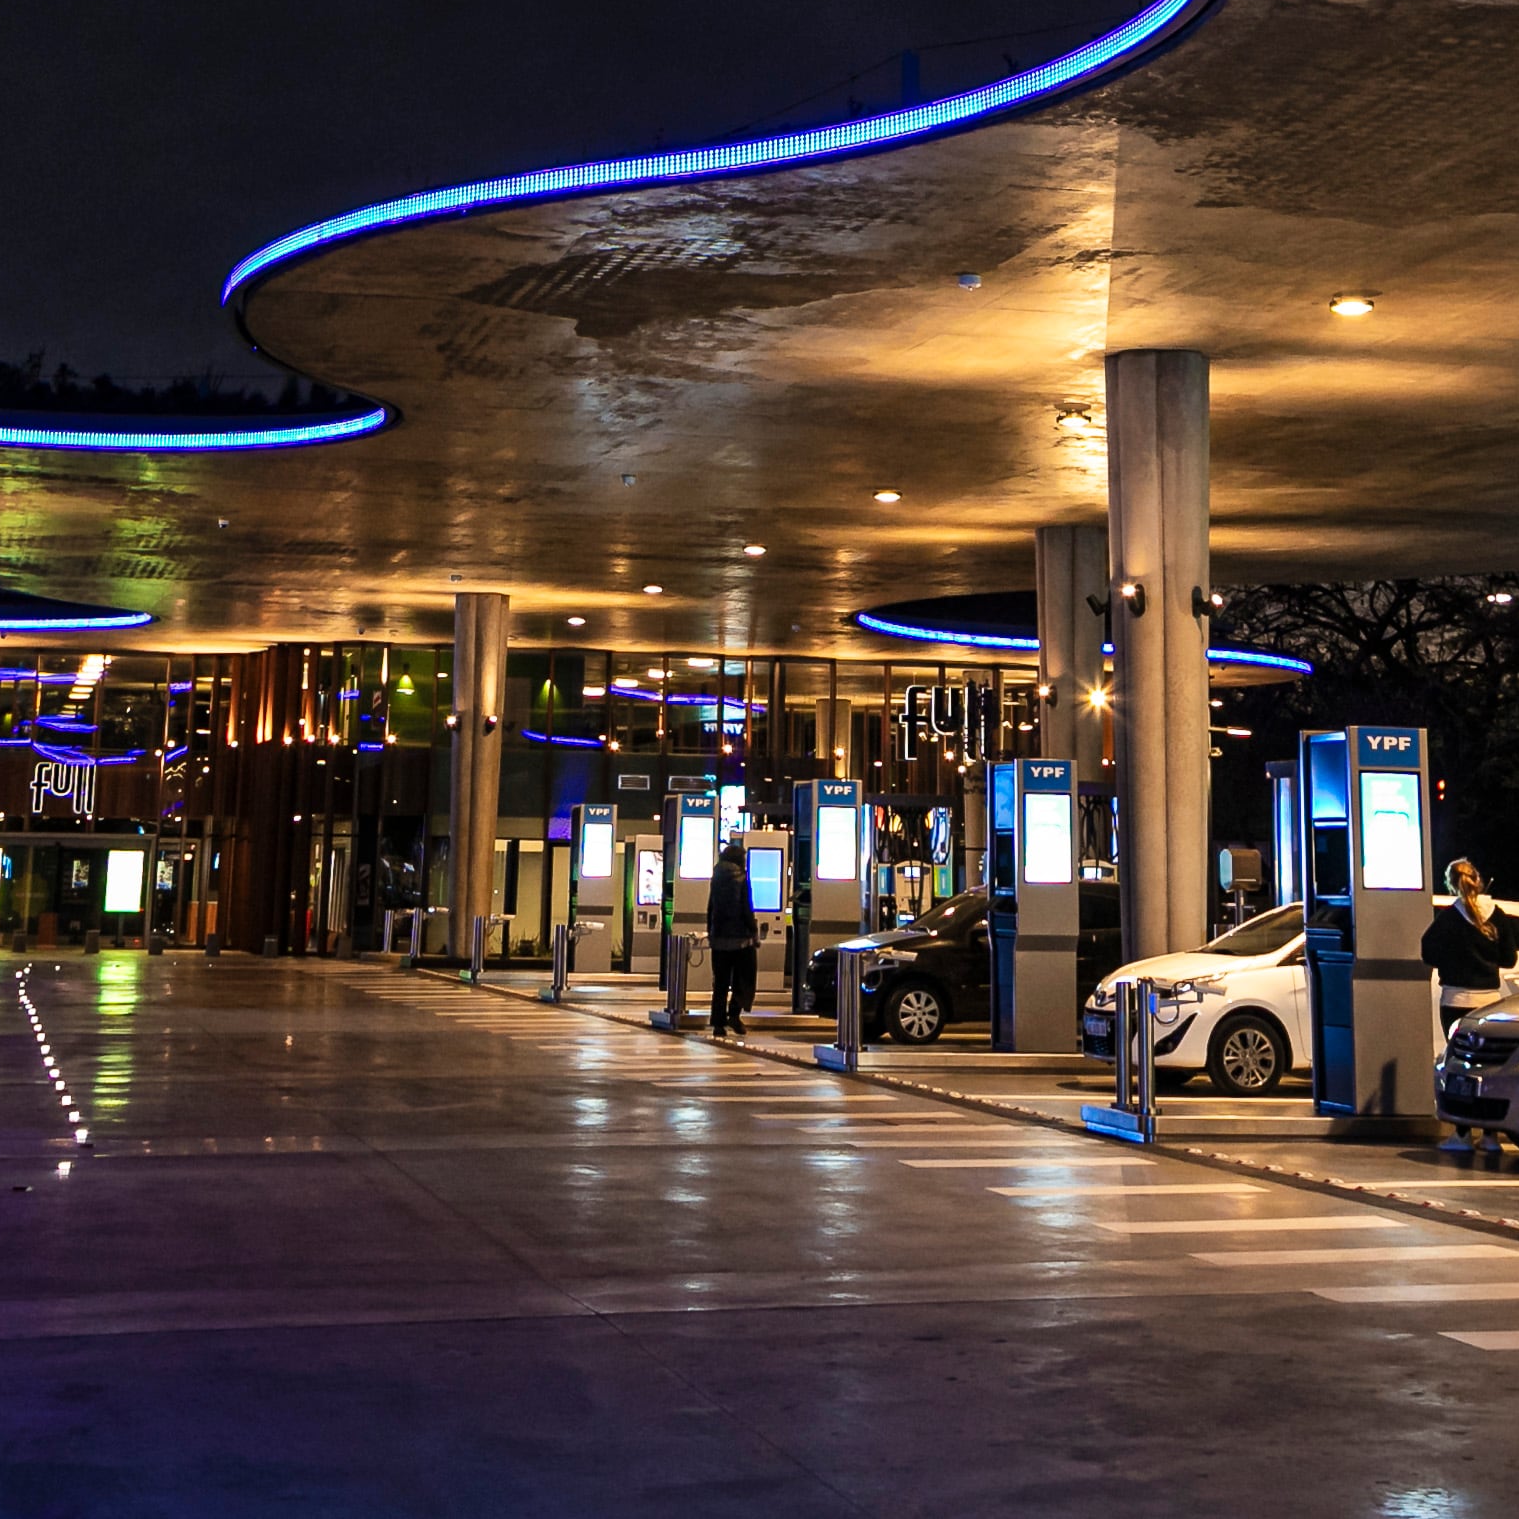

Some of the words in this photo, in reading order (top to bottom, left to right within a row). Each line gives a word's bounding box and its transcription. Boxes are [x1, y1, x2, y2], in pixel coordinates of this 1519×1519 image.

[899, 685, 994, 762] full
[1366, 735, 1412, 751] YPF
[1030, 766, 1065, 779] YPF
[30, 761, 97, 814] full
[823, 784, 853, 796] YPF
[686, 798, 712, 808] YPF
[588, 807, 610, 816] YPF
